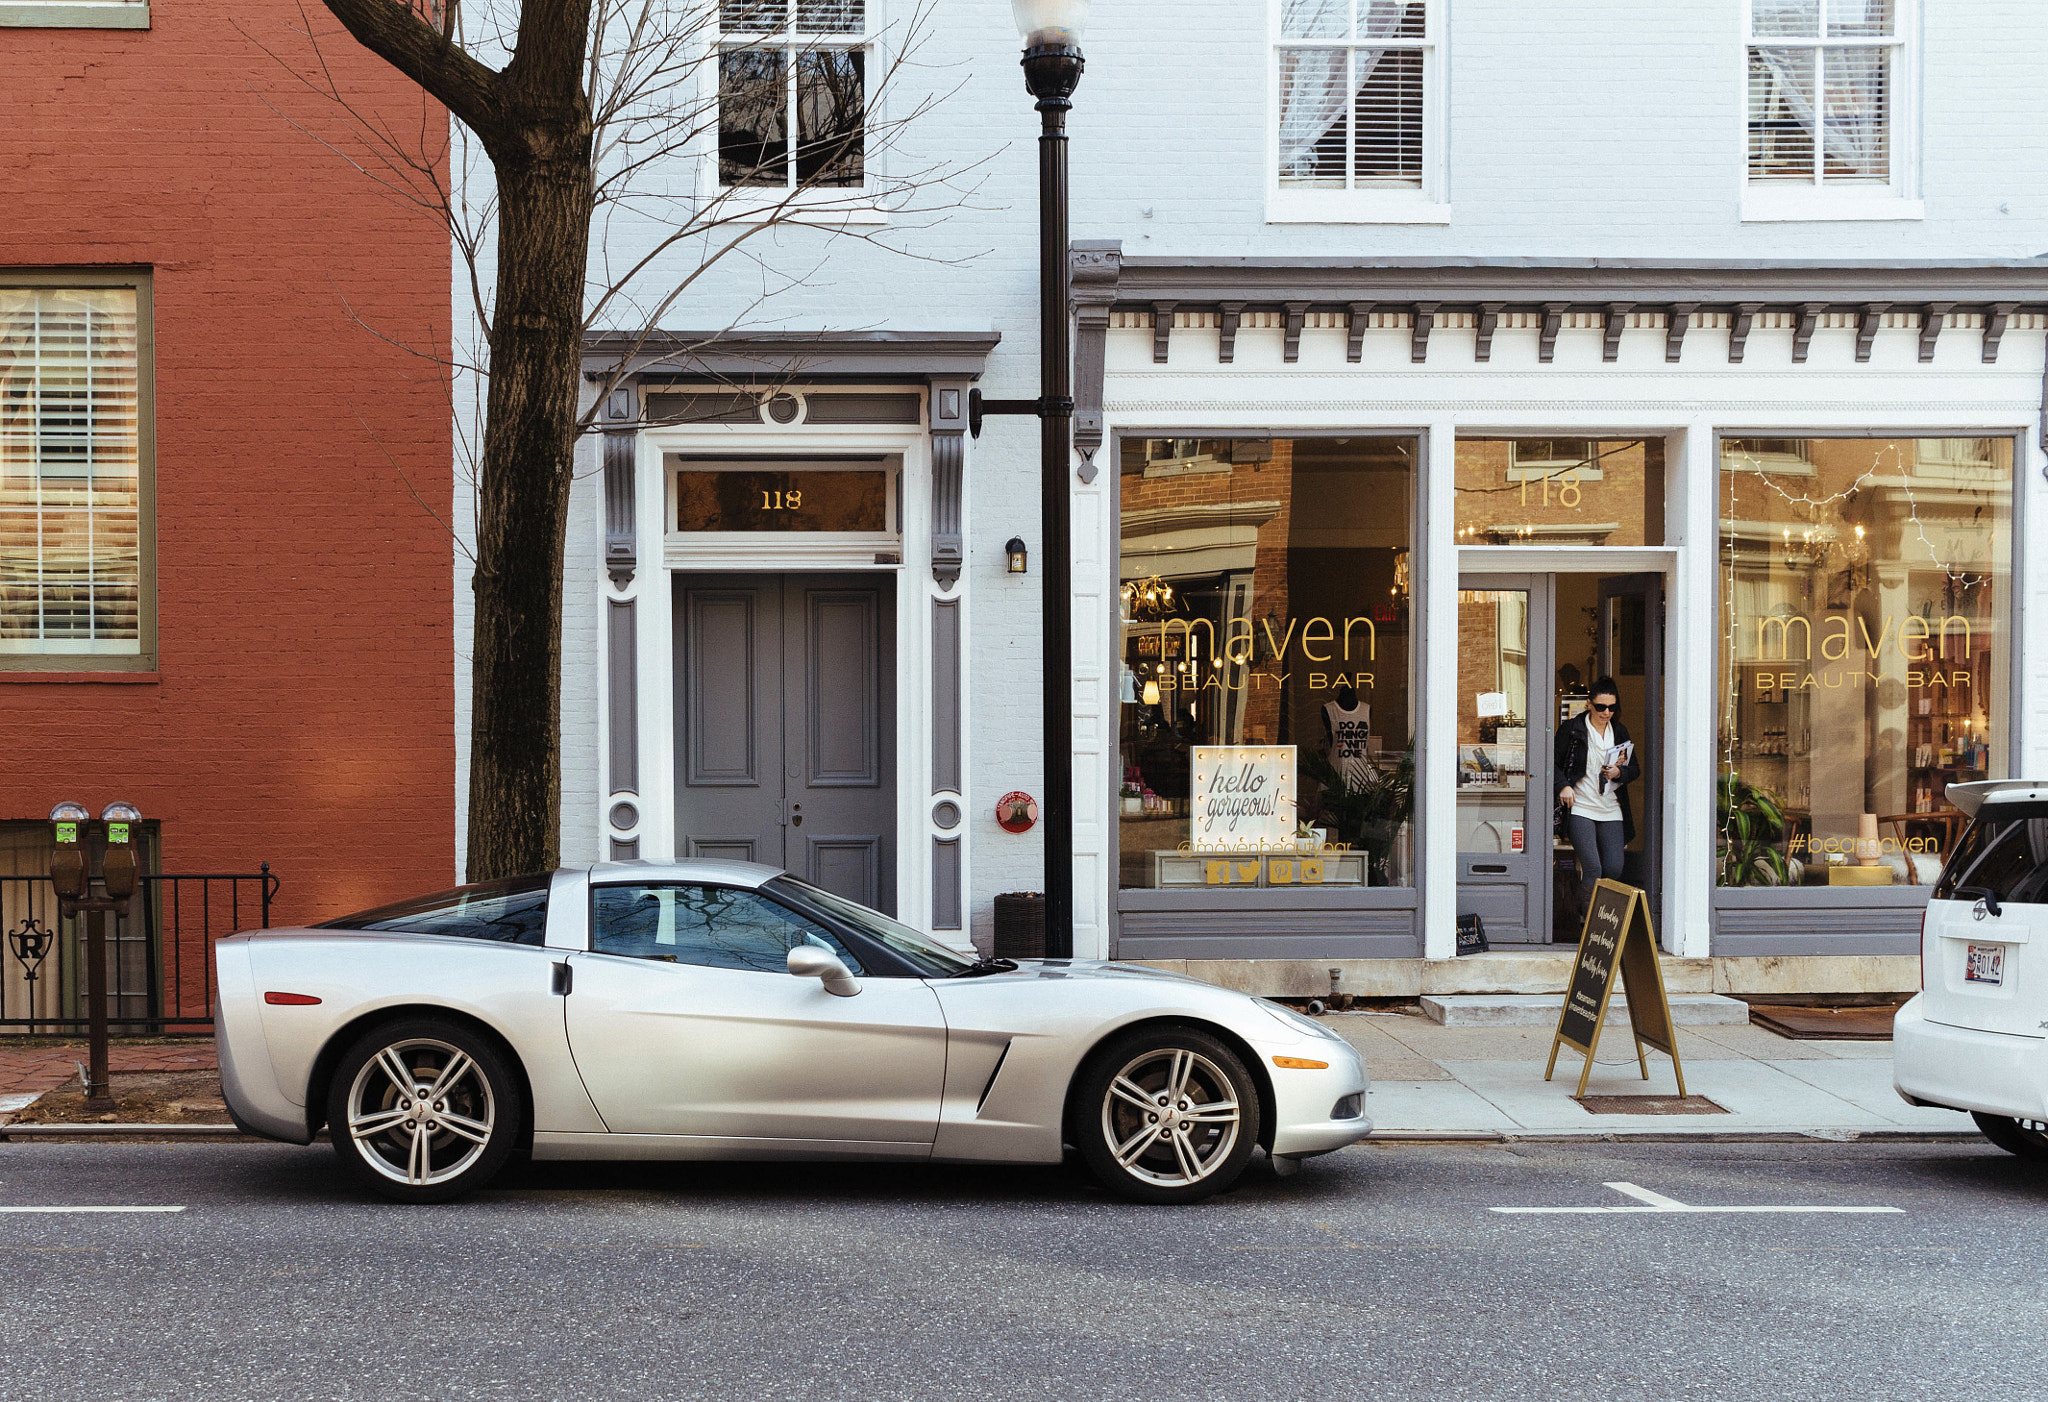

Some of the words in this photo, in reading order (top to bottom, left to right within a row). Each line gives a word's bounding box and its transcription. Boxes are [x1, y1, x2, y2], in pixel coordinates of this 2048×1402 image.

[761, 490, 803, 510] 118
[1521, 471, 1581, 508] 118
[1160, 616, 1375, 662] maven
[1758, 615, 1971, 661] maven
[1158, 672, 1291, 691] BEAUTY
[1309, 672, 1375, 689] BAR
[1756, 671, 1888, 689] BEAUTY
[1906, 671, 1971, 688] BAR
[1339, 721, 1355, 729] DO
[1208, 763, 1267, 794] hello
[1204, 788, 1280, 832] gorgeous!
[1176, 838, 1352, 858] @mavenbeautybar
[1788, 833, 1938, 854] #beamaven
[18, 934, 44, 959] R
